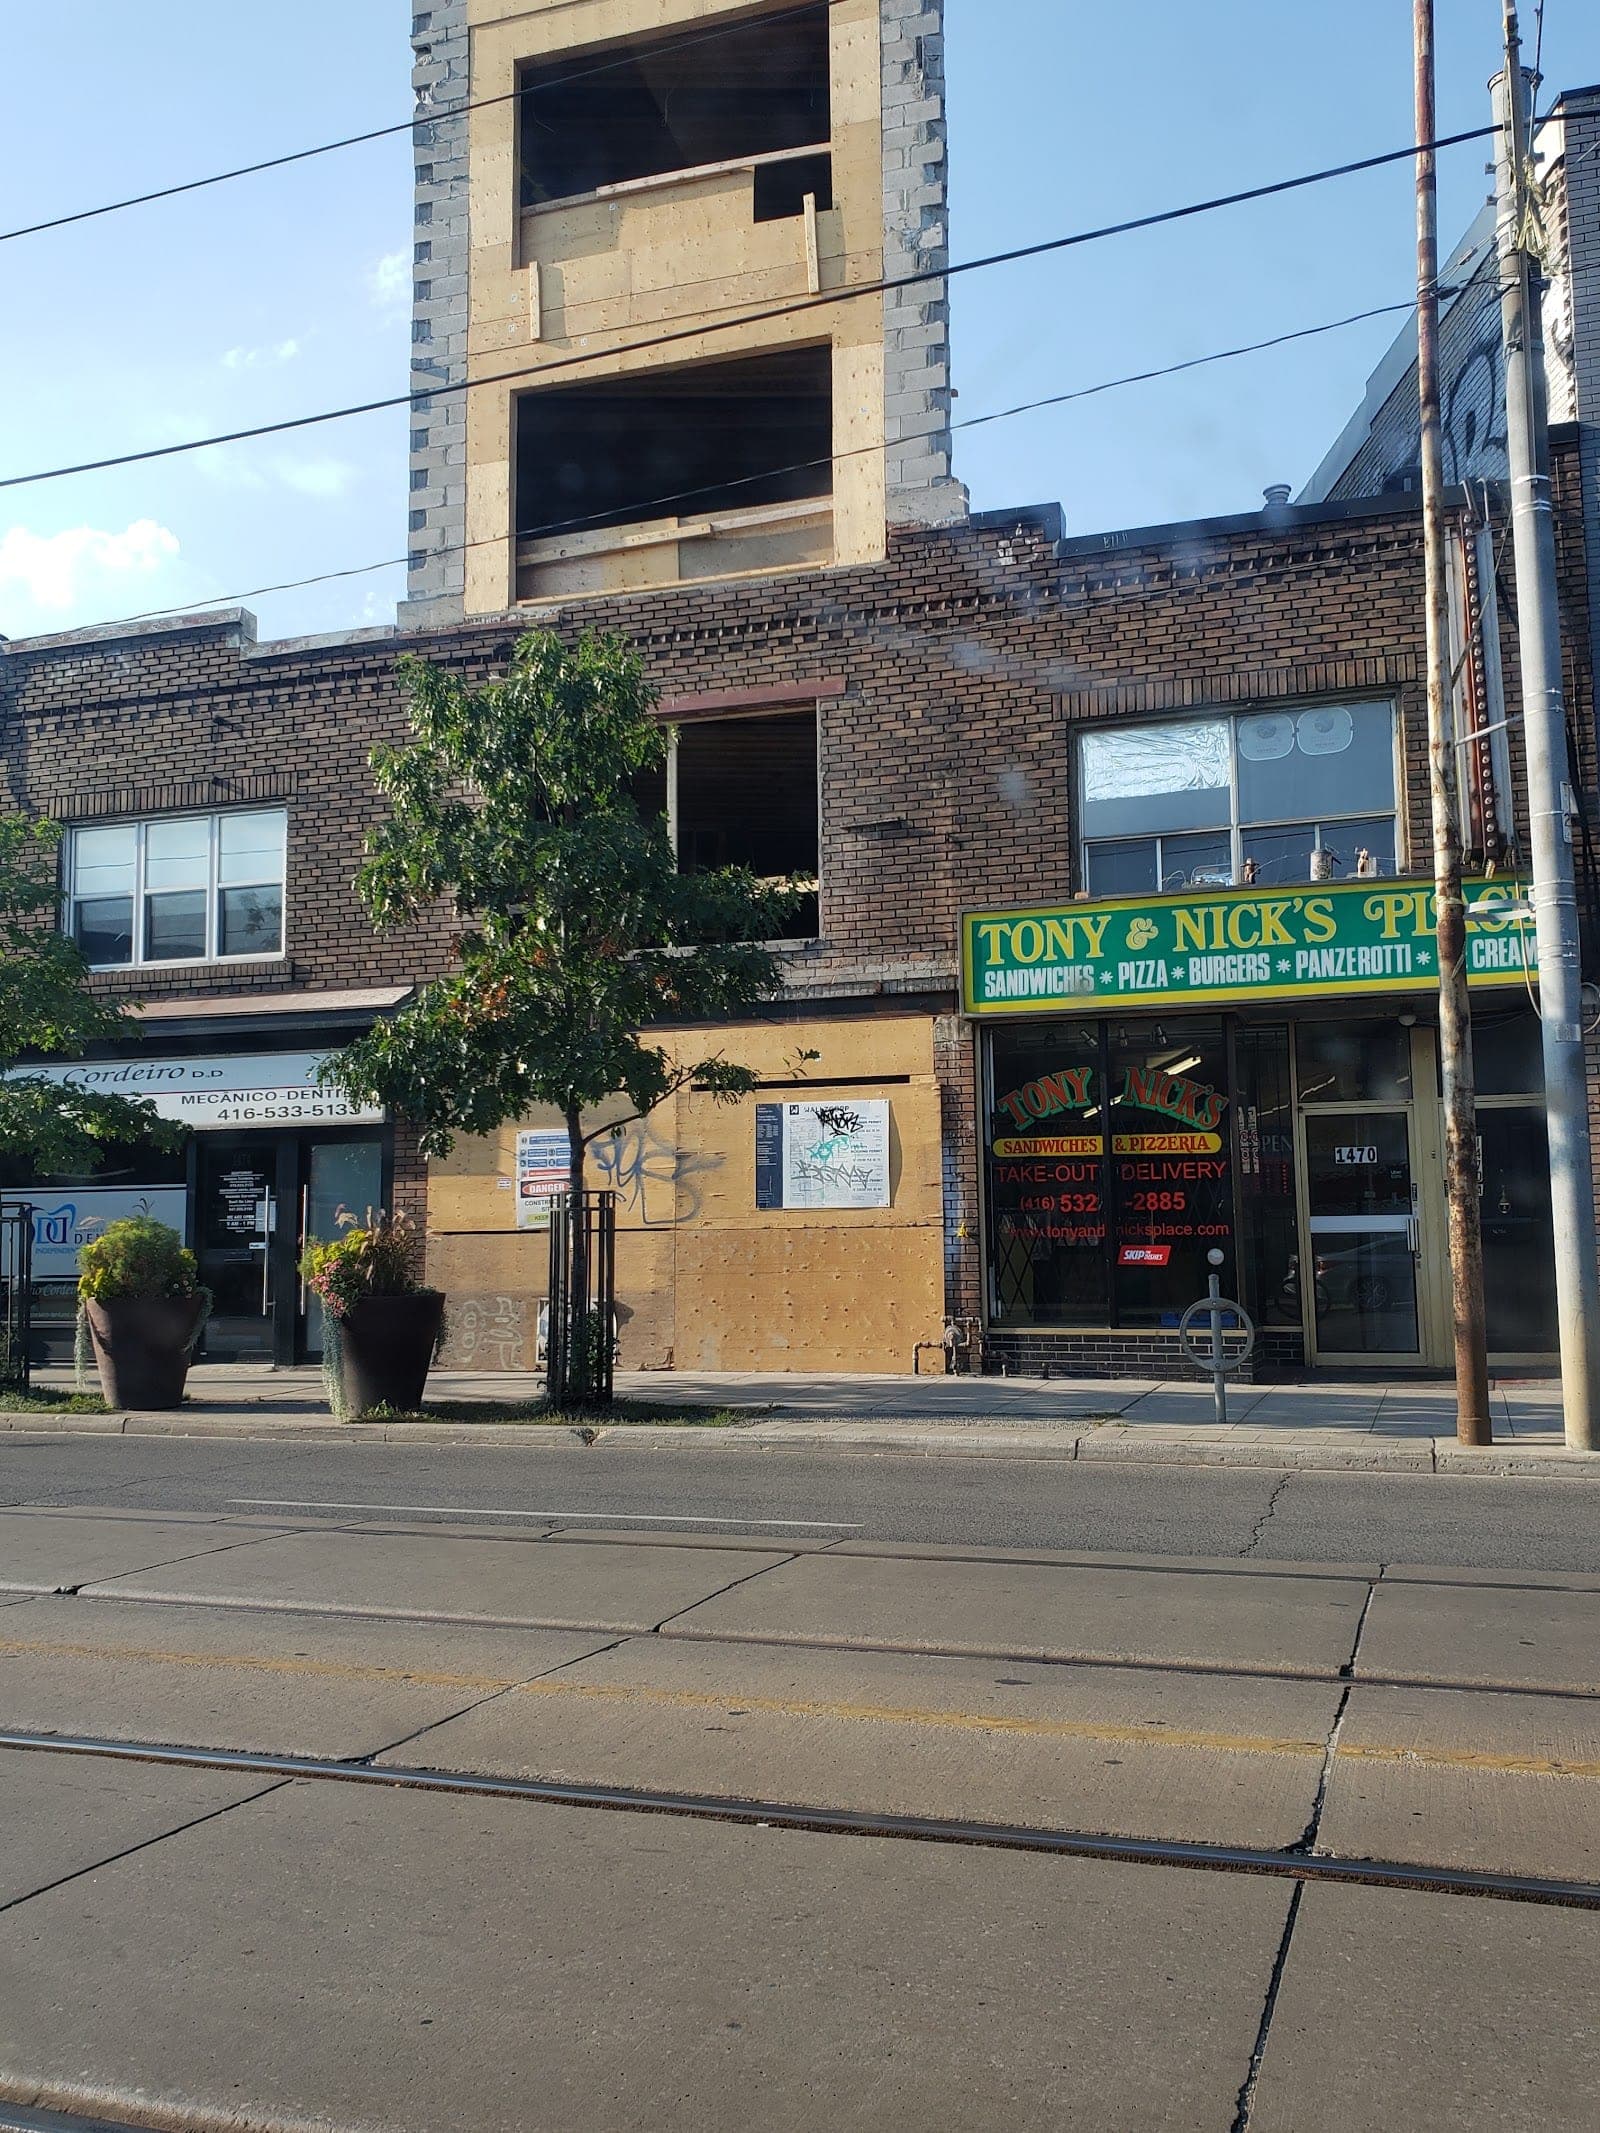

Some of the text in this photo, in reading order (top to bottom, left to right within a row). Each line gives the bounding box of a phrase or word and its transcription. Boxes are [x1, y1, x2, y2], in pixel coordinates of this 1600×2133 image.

[978, 886, 1537, 965] TONY & NICK'S PLCE
[984, 964, 1094, 998] SANDWICHES
[1118, 959, 1168, 990] PIZZA
[1188, 952, 1271, 987] BURGERS
[1296, 943, 1412, 979] PANZEROTTI
[63, 1064, 186, 1084] Cordeiro
[998, 1066, 1093, 1132] TONY
[218, 1103, 361, 1121] 416-533-5133
[1004, 1135, 1211, 1154] SANDWICHES & PIZZERIA
[1262, 1135, 1293, 1153] PEN
[1336, 1147, 1376, 1162] 1470
[997, 1161, 1227, 1183] TAKE-OUT DELIVERY
[529, 1183, 565, 1194] DANGER
[1019, 1192, 1186, 1213] (416) 532 -2885
[1115, 1222, 1229, 1240] nicksplace.com
[1123, 1250, 1145, 1260] SKIP
